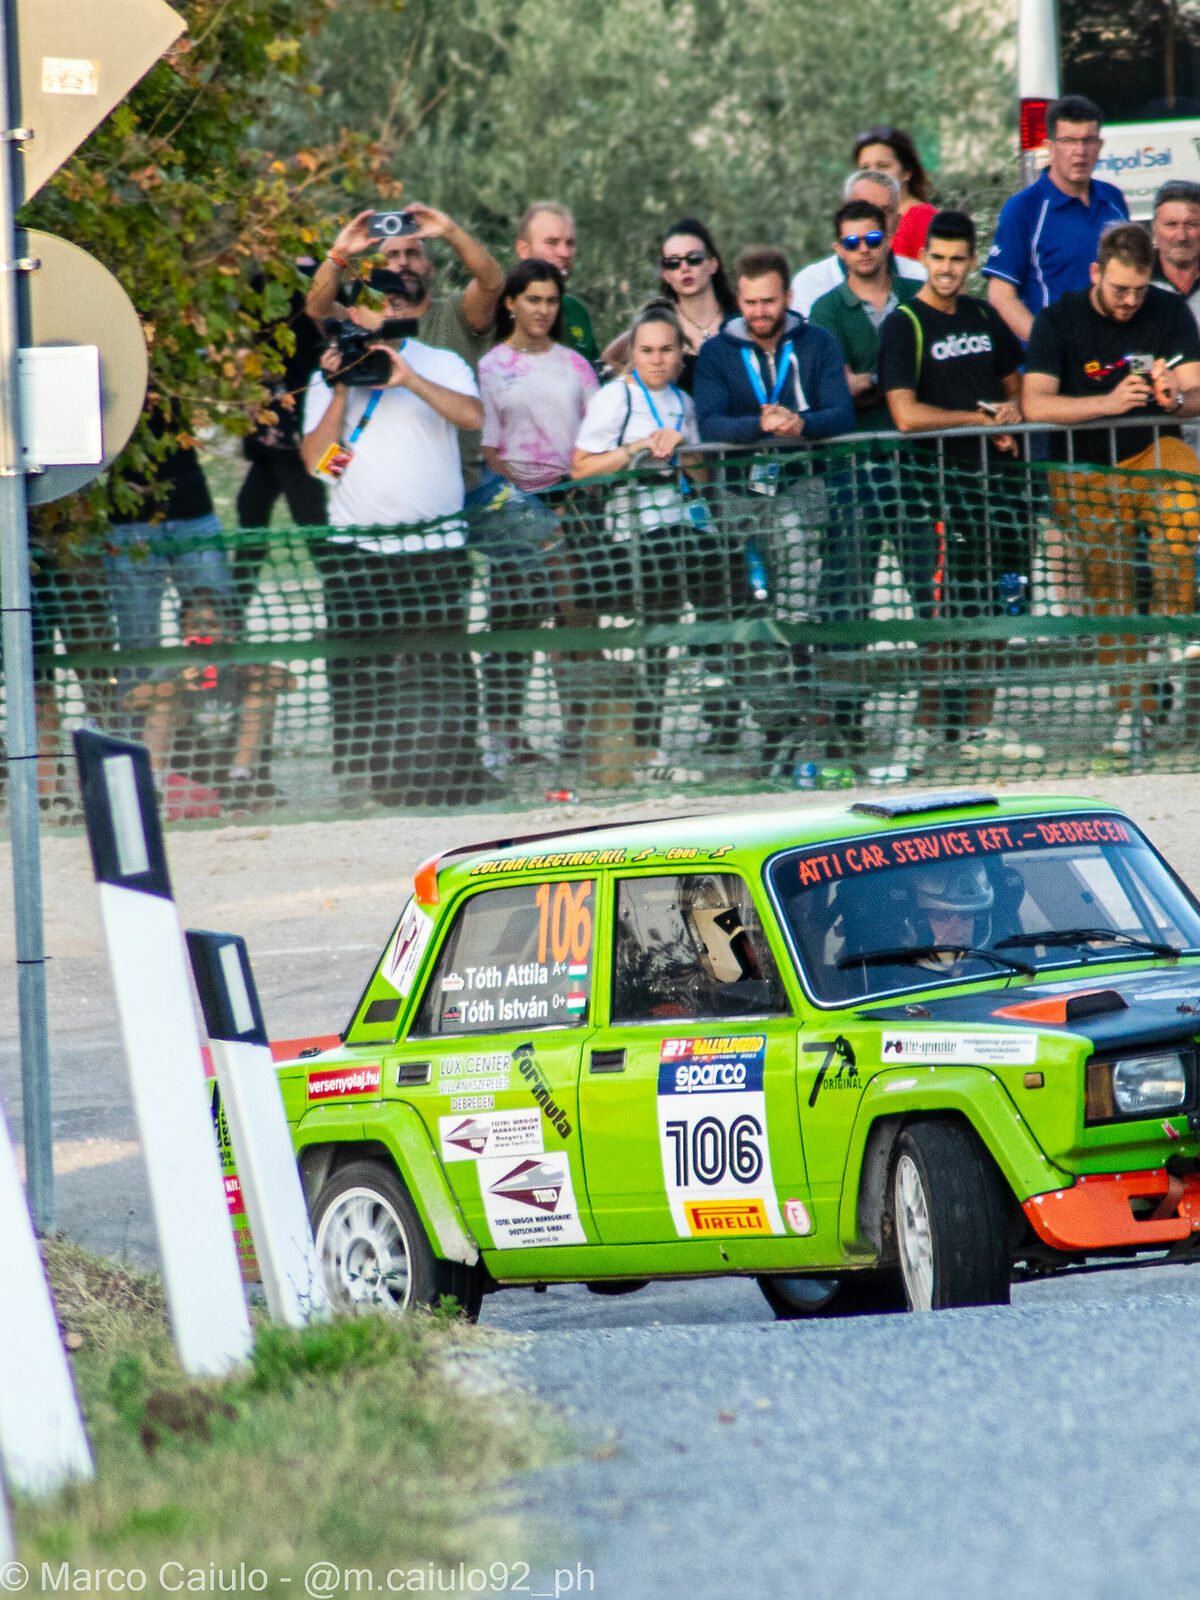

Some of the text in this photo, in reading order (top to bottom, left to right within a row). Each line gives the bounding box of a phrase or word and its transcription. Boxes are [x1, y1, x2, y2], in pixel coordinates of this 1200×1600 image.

[1095, 147, 1172, 175] nipolSai
[931, 332, 993, 361] adidas
[526, 850, 599, 870] ELECTRIC
[799, 853, 843, 886] ATTI
[845, 844, 891, 873] CAR
[891, 831, 976, 864] SERVICE
[1036, 820, 1131, 845] DEBRECEN
[535, 879, 592, 964] 106
[465, 965, 502, 990] Tóth
[505, 962, 549, 987] Attila
[458, 1000, 495, 1024] Tóth
[499, 996, 549, 1021] István
[440, 1054, 512, 1076] LUX CENTER
[675, 1063, 747, 1093] sparco
[308, 1071, 380, 1094] versenyolaj.hu
[823, 1078, 863, 1090] ORIGINAL
[665, 1114, 764, 1187] 106
[691, 1205, 763, 1230] PIRELLI
